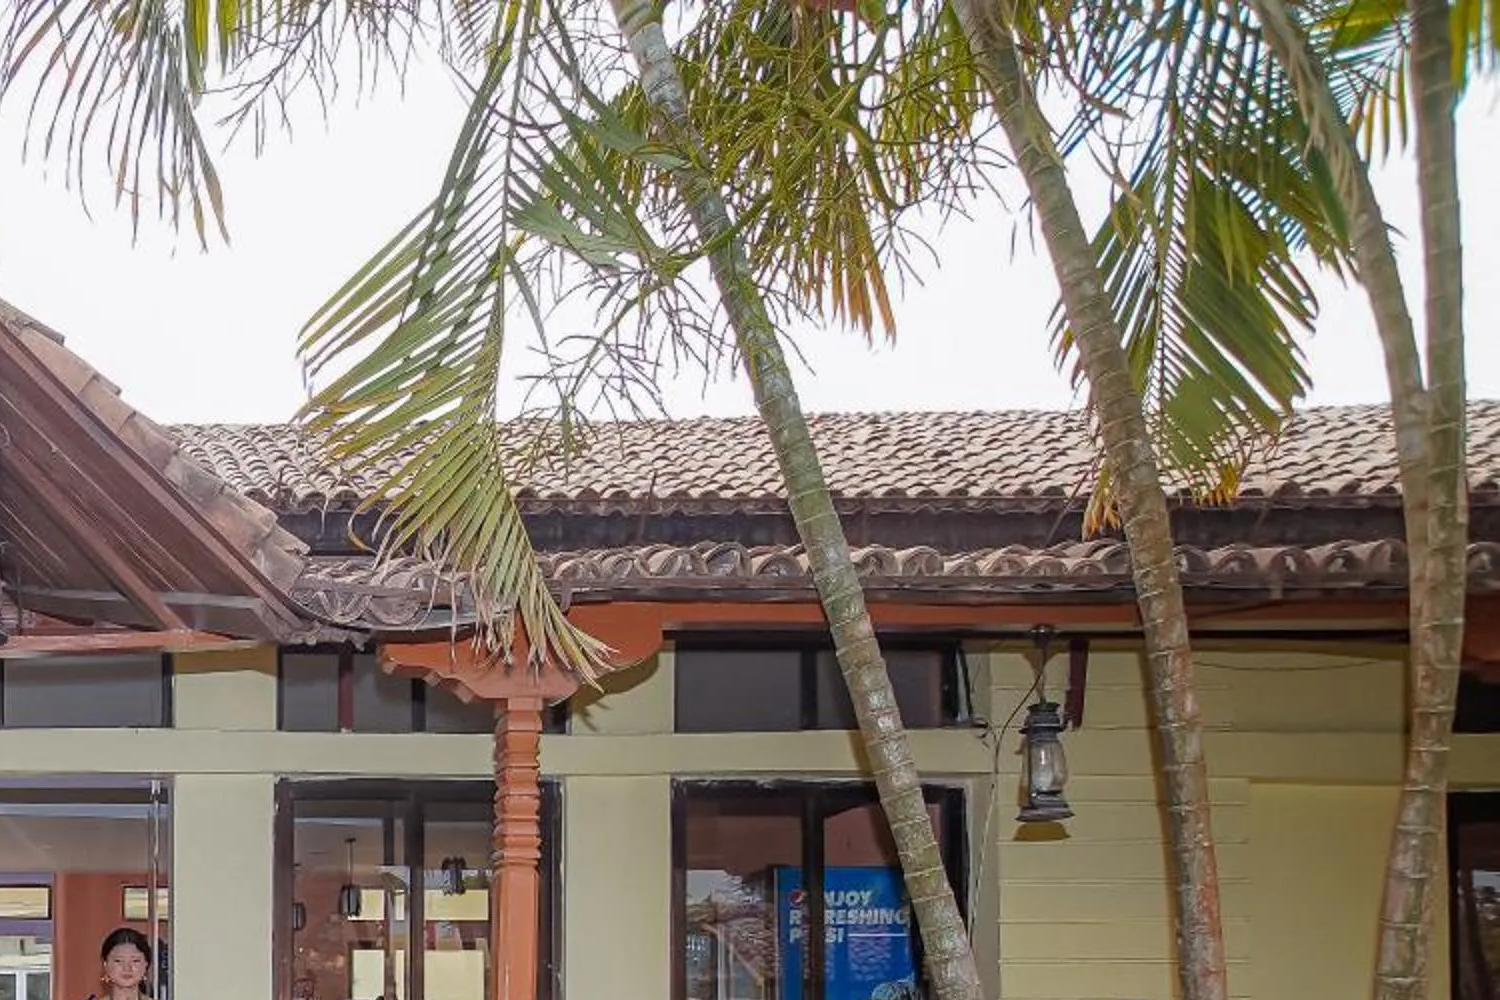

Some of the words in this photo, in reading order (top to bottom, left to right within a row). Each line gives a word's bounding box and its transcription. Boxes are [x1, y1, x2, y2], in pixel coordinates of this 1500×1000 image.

[823, 890, 873, 907] NJOY
[789, 908, 910, 925] RRESHING
[789, 928, 845, 944] PSI
